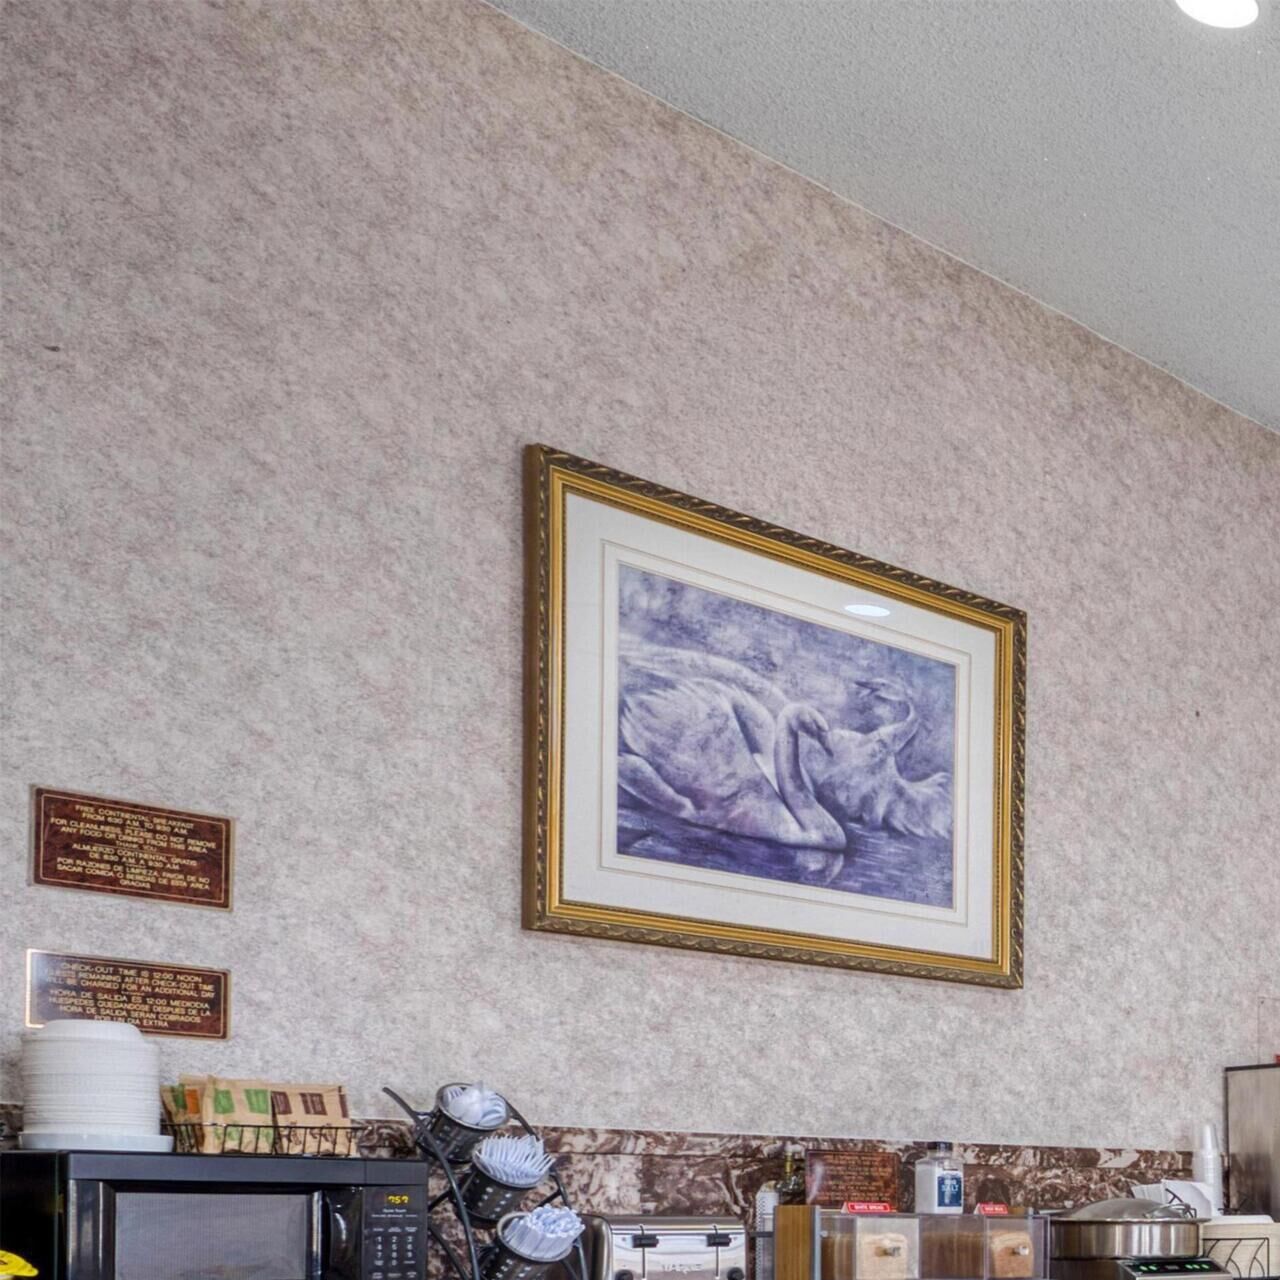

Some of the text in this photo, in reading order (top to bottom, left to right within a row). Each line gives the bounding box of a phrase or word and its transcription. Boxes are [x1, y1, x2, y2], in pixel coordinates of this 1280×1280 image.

[75, 805, 194, 829] FREE CONTINENTAL BREAKFAST
[82, 813, 105, 822] FROM
[50, 817, 68, 825] FOR
[124, 829, 154, 839] PLEASE
[155, 833, 168, 841] DO
[170, 836, 185, 844] NOT
[187, 838, 216, 849] REMOVE
[60, 826, 78, 834] ANY
[80, 829, 103, 838] FOOD
[146, 839, 167, 848] FROM
[187, 845, 208, 854] AREA
[72, 843, 198, 867] ALMUERZO CONTINENTAL GRATIS
[89, 852, 100, 860] DE
[57, 857, 74, 865] POR
[76, 859, 111, 871] RAZONES
[113, 864, 124, 872] DE
[187, 875, 198, 883] DE
[199, 877, 210, 885] NO
[57, 864, 83, 874] SACAR
[85, 868, 115, 878] COMIDA
[190, 881, 210, 890] AREA
[119, 879, 151, 889] GRACIAS
[60, 963, 114, 974] CHECK-OUT
[118, 968, 137, 977] TIME
[176, 974, 203, 983] NOON
[78, 972, 121, 983] REMAINING
[125, 976, 149, 985] AFTER
[151, 979, 196, 990] CHECK-OUT
[198, 983, 215, 992] TIME
[80, 980, 119, 990] CHARGED
[140, 985, 153, 993] AN
[154, 986, 199, 998] ADDITIONAL
[201, 990, 216, 999] DAY
[81, 991, 93, 999] DE
[96, 992, 128, 1002] SALIDA
[131, 996, 142, 1004] ES
[169, 999, 210, 1009] MEDIODIA
[97, 1000, 151, 1012] QUEDANDOSE
[152, 1005, 186, 1015] DESPUES
[187, 1008, 198, 1016] DE
[200, 1009, 211, 1017] LA
[60, 1004, 202, 1023] HORA DE SALIDA SERAN COBRADOS
[142, 1019, 169, 1028] EXTRA
